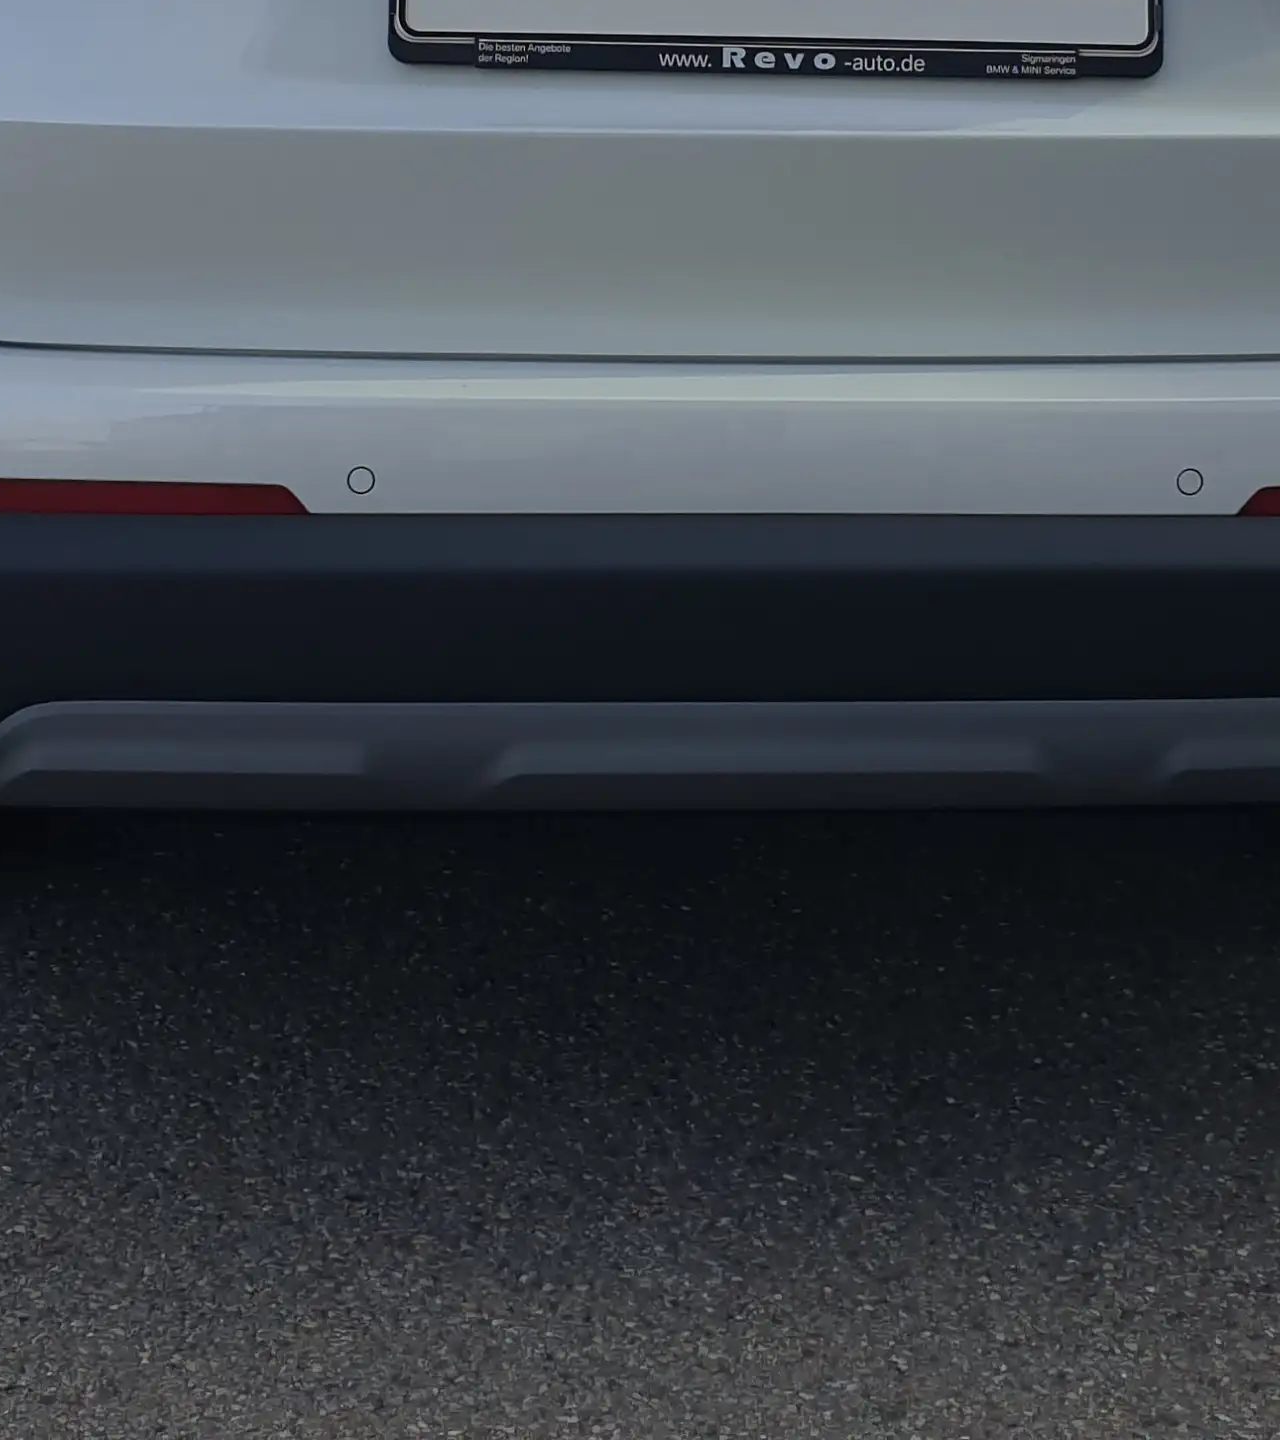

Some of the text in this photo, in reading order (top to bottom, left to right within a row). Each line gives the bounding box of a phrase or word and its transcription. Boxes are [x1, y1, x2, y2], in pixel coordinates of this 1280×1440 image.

[478, 42, 571, 54] Die besten Angebote
[478, 53, 529, 64] der Region!
[1021, 53, 1076, 64] Sigmaringen
[986, 65, 1011, 74] BMW
[1021, 65, 1042, 74] MINI
[1043, 65, 1076, 75] Service
